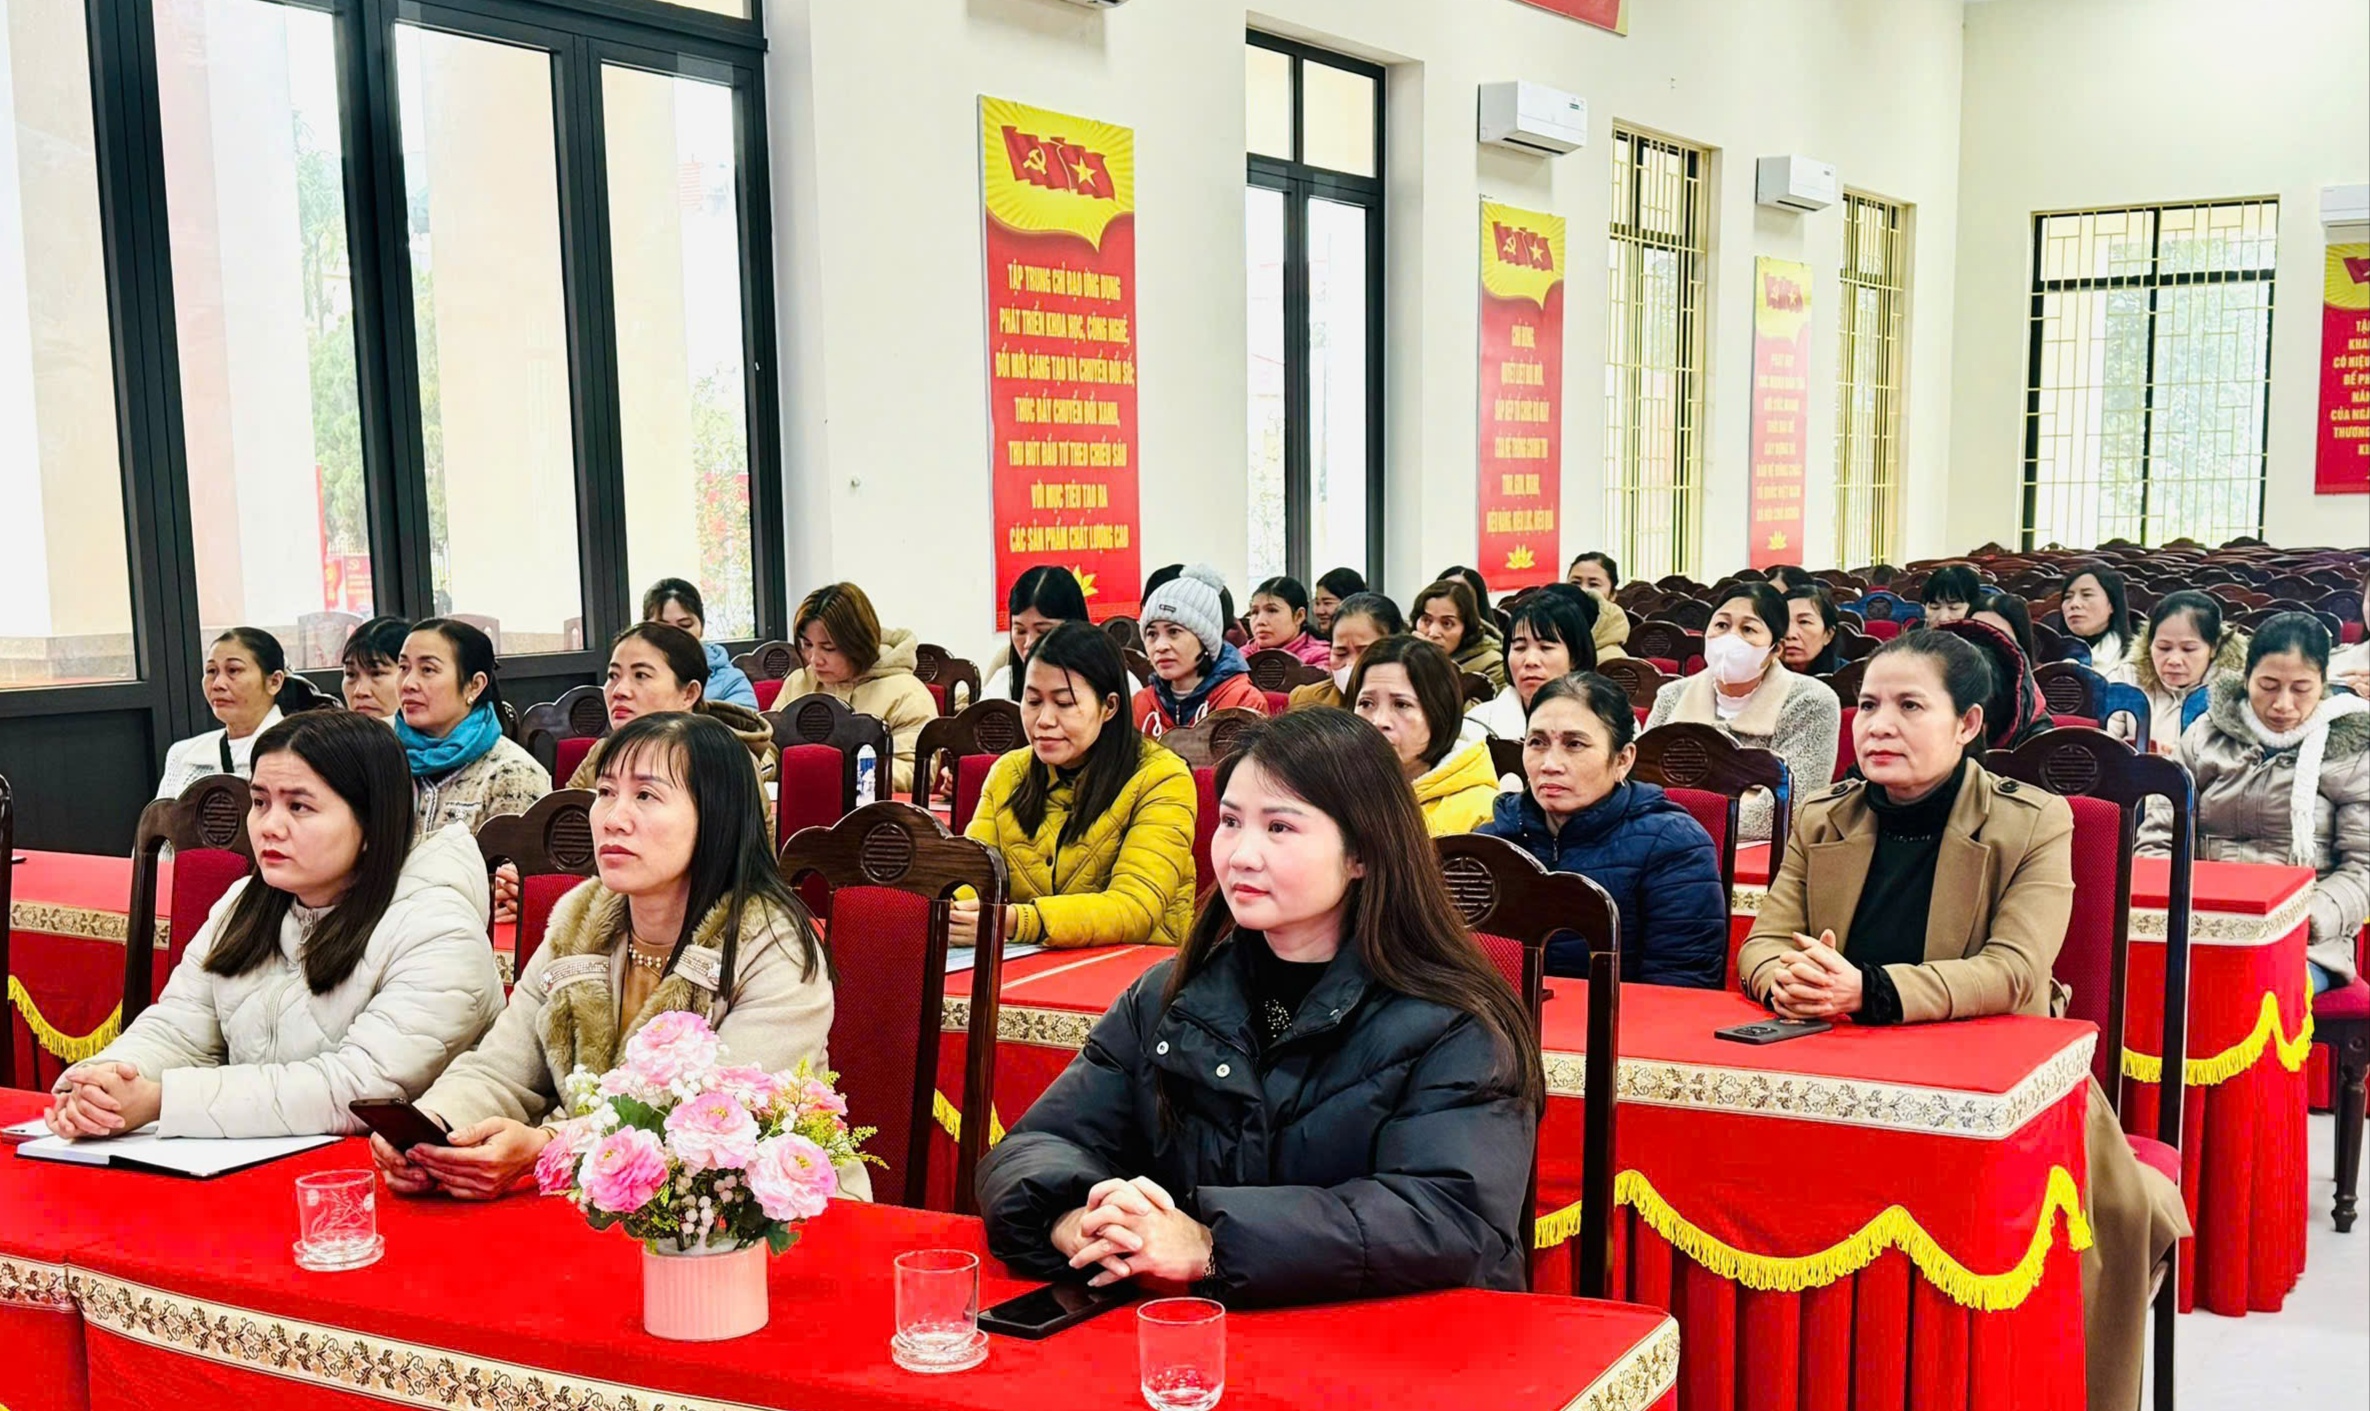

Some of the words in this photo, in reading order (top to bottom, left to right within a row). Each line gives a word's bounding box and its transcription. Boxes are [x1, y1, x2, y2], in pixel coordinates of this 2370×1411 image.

[1007, 258, 1023, 296] TẬP
[1025, 265, 1051, 293] TRUNG
[1000, 302, 1020, 335] PHÁT
[1021, 300, 1045, 336] TRIỂN
[1028, 349, 1050, 380] SÁNG
[1051, 355, 1066, 386] TẠO
[1009, 522, 1026, 553] CÁC
[1114, 524, 1129, 549] CAO
